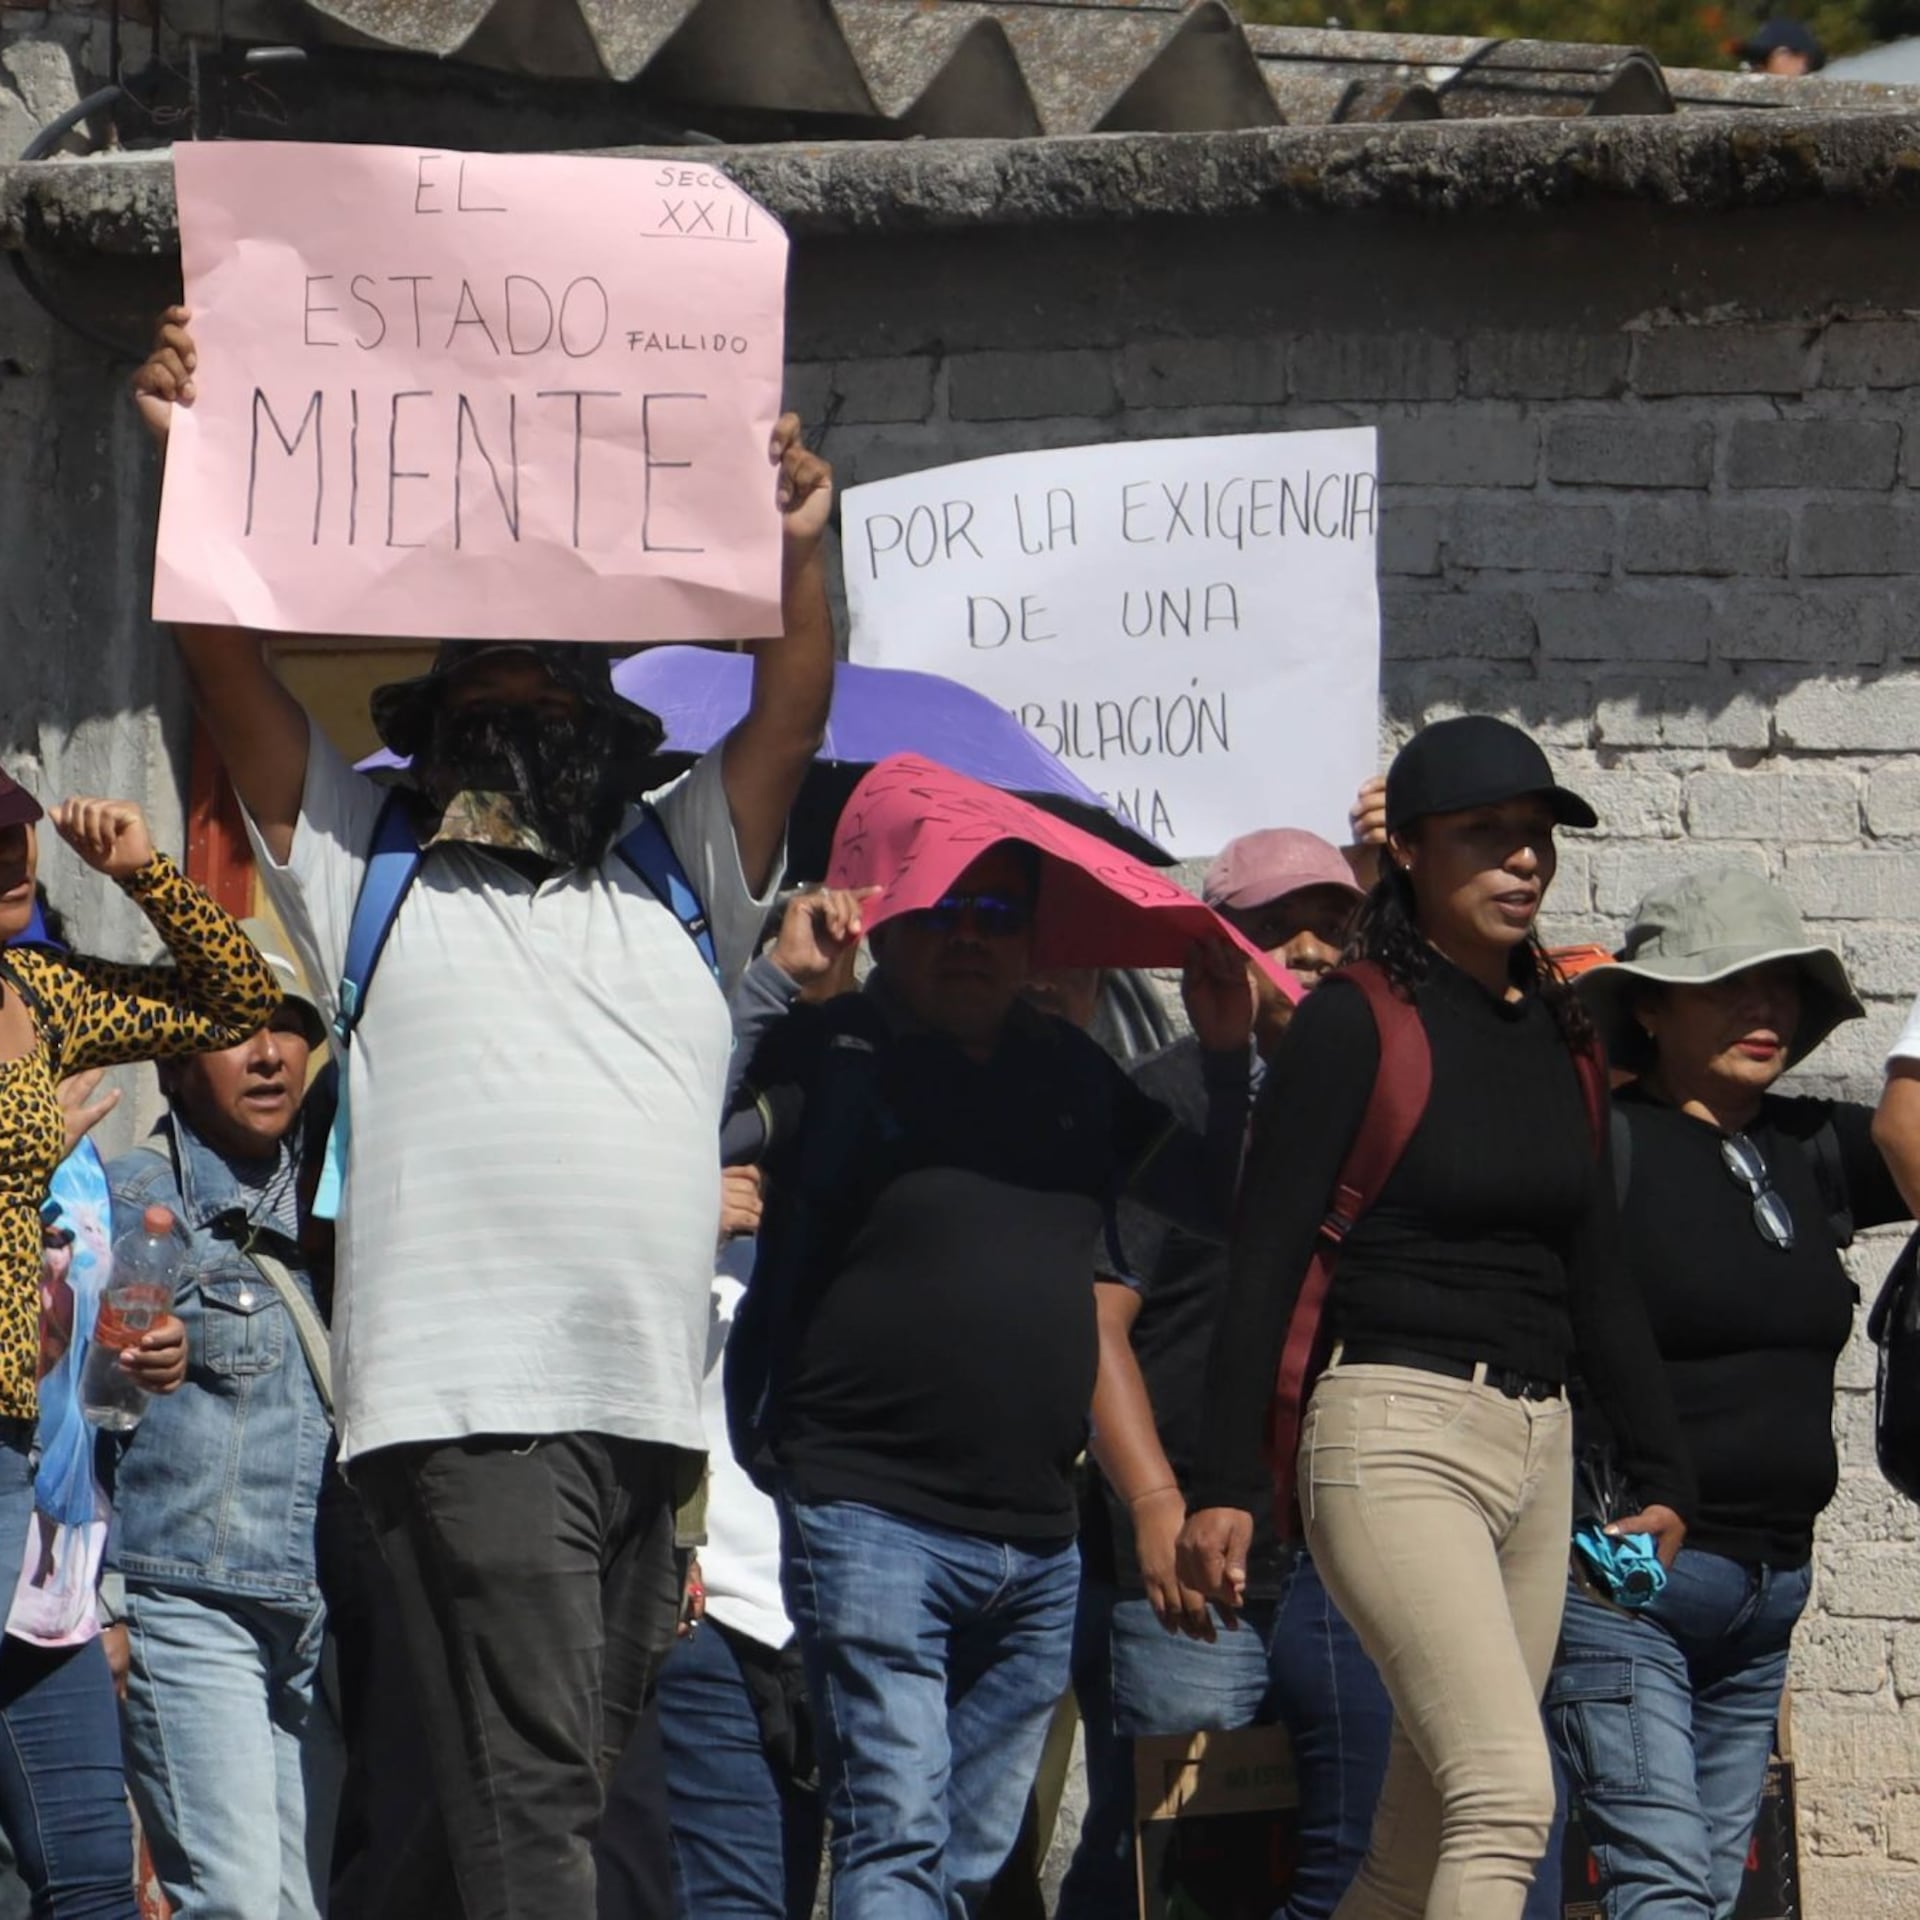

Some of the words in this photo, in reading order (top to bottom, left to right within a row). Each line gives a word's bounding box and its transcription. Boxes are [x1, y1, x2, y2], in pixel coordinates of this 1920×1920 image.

[414, 155, 508, 214] EL
[658, 199, 752, 238] XXII
[303, 274, 609, 358] ESTADO
[626, 330, 748, 355] FALLIDO
[245, 386, 707, 553] MIENTE
[864, 499, 984, 580] POR
[1014, 487, 1078, 555] LA
[1120, 469, 1379, 551] EXIGENCIA
[966, 593, 1058, 650] DE
[1121, 581, 1240, 638] UNA
[1011, 676, 1230, 761] BILACIÓN
[1099, 787, 1176, 839] NA
